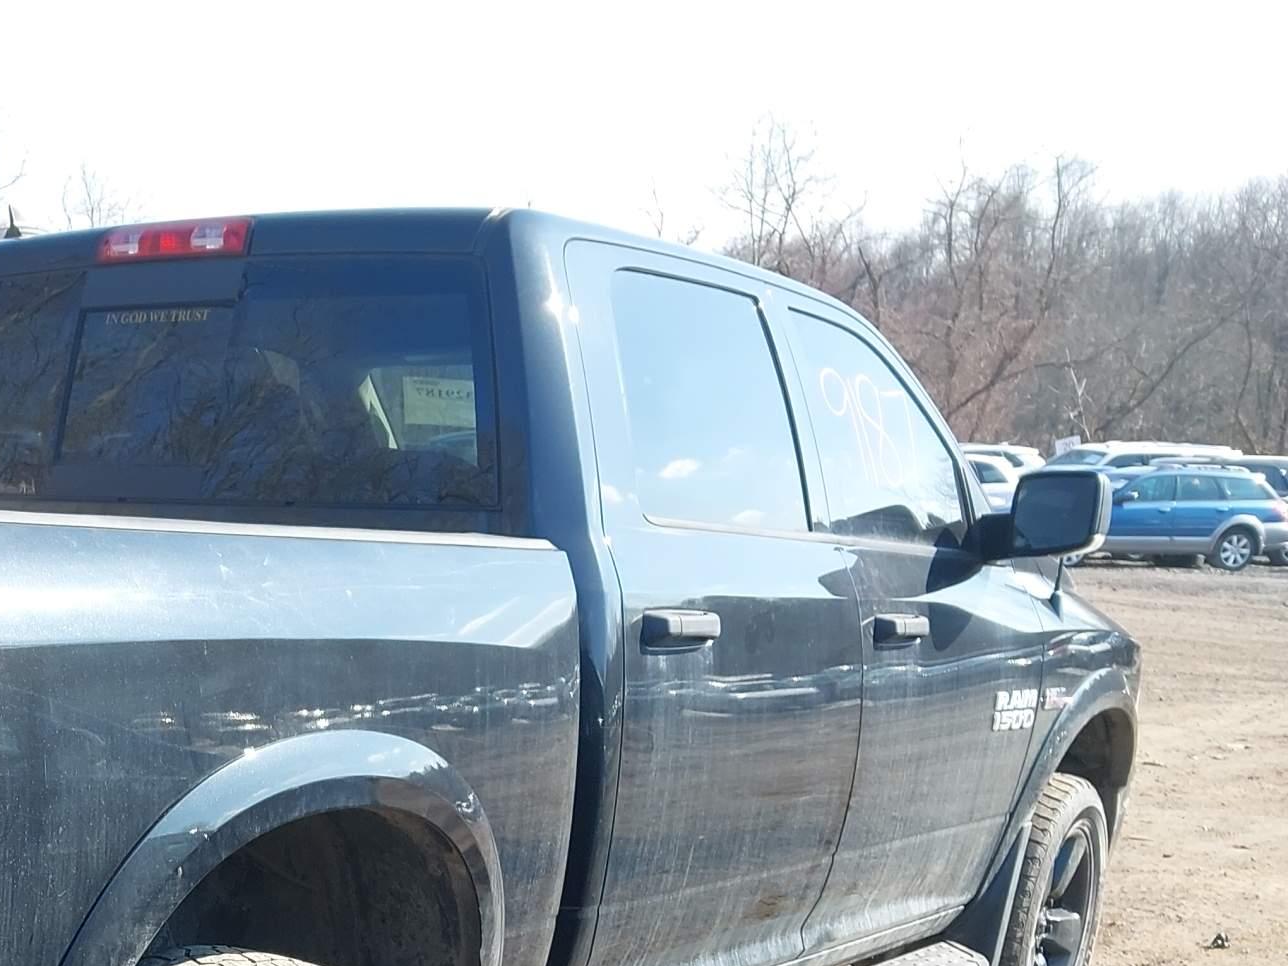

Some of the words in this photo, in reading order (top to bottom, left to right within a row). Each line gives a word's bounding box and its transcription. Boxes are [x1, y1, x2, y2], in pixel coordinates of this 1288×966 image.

[120, 311, 147, 324] GOD
[171, 309, 208, 321] TRUST
[995, 688, 1039, 711] RAM
[992, 709, 1035, 732] 1500
